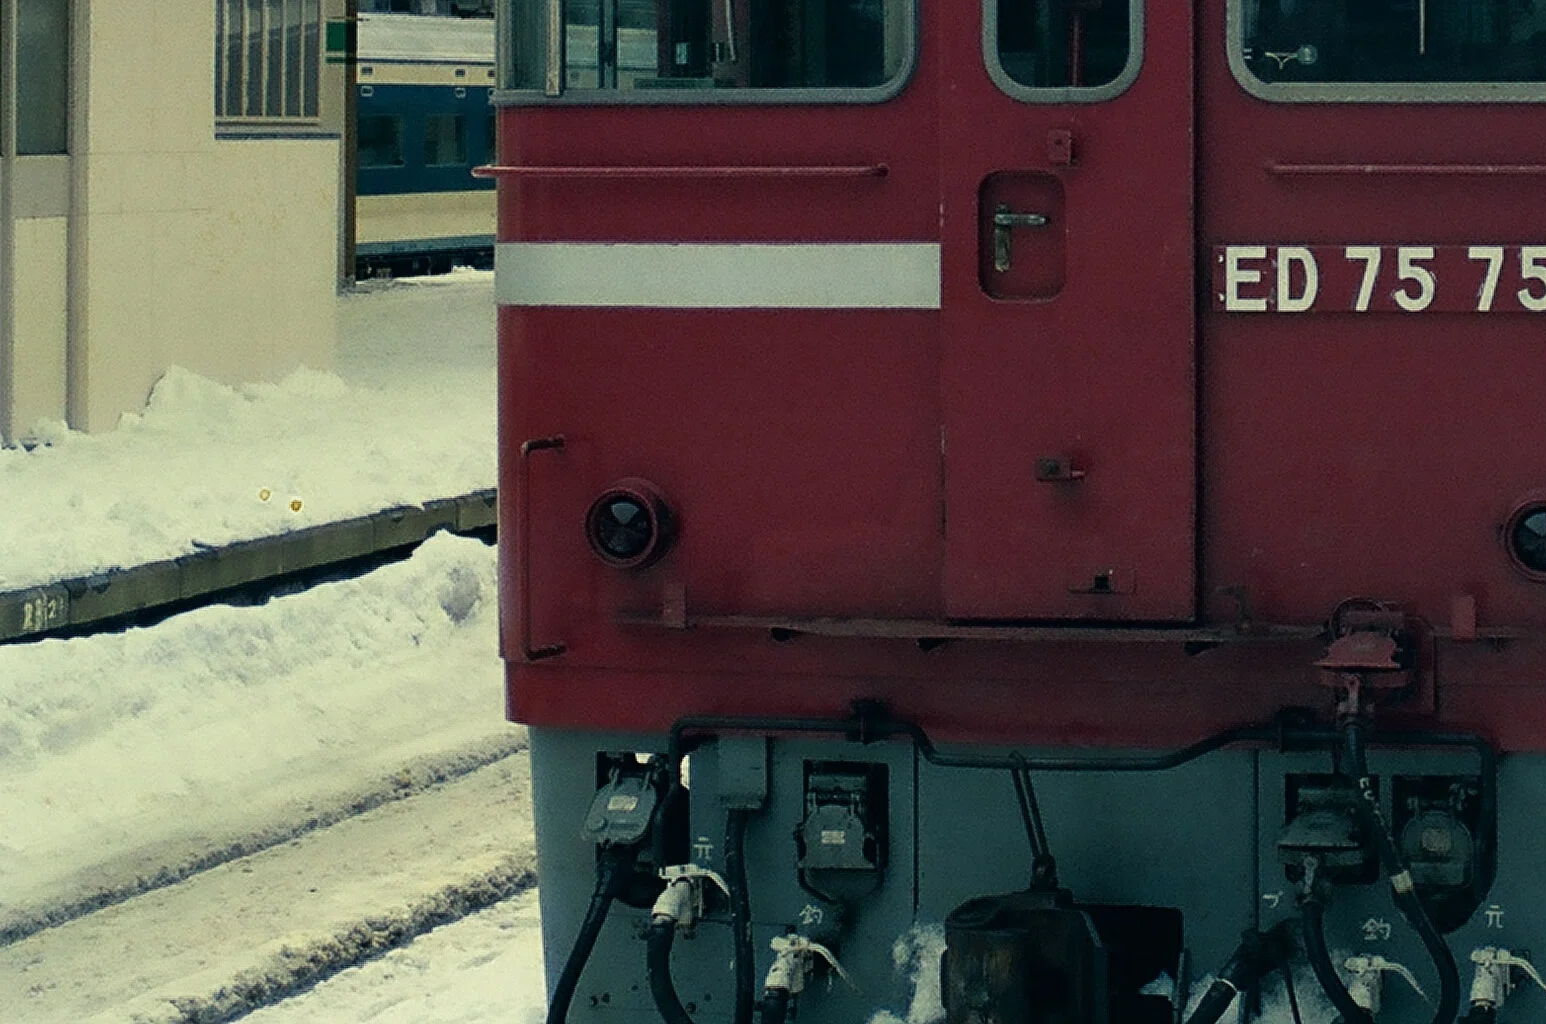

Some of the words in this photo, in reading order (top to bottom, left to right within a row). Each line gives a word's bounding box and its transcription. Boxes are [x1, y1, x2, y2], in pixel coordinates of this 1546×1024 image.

[1225, 245, 1318, 312] ED
[1345, 245, 1436, 312] 75
[693, 837, 714, 860] 元
[1484, 904, 1504, 929] 元
